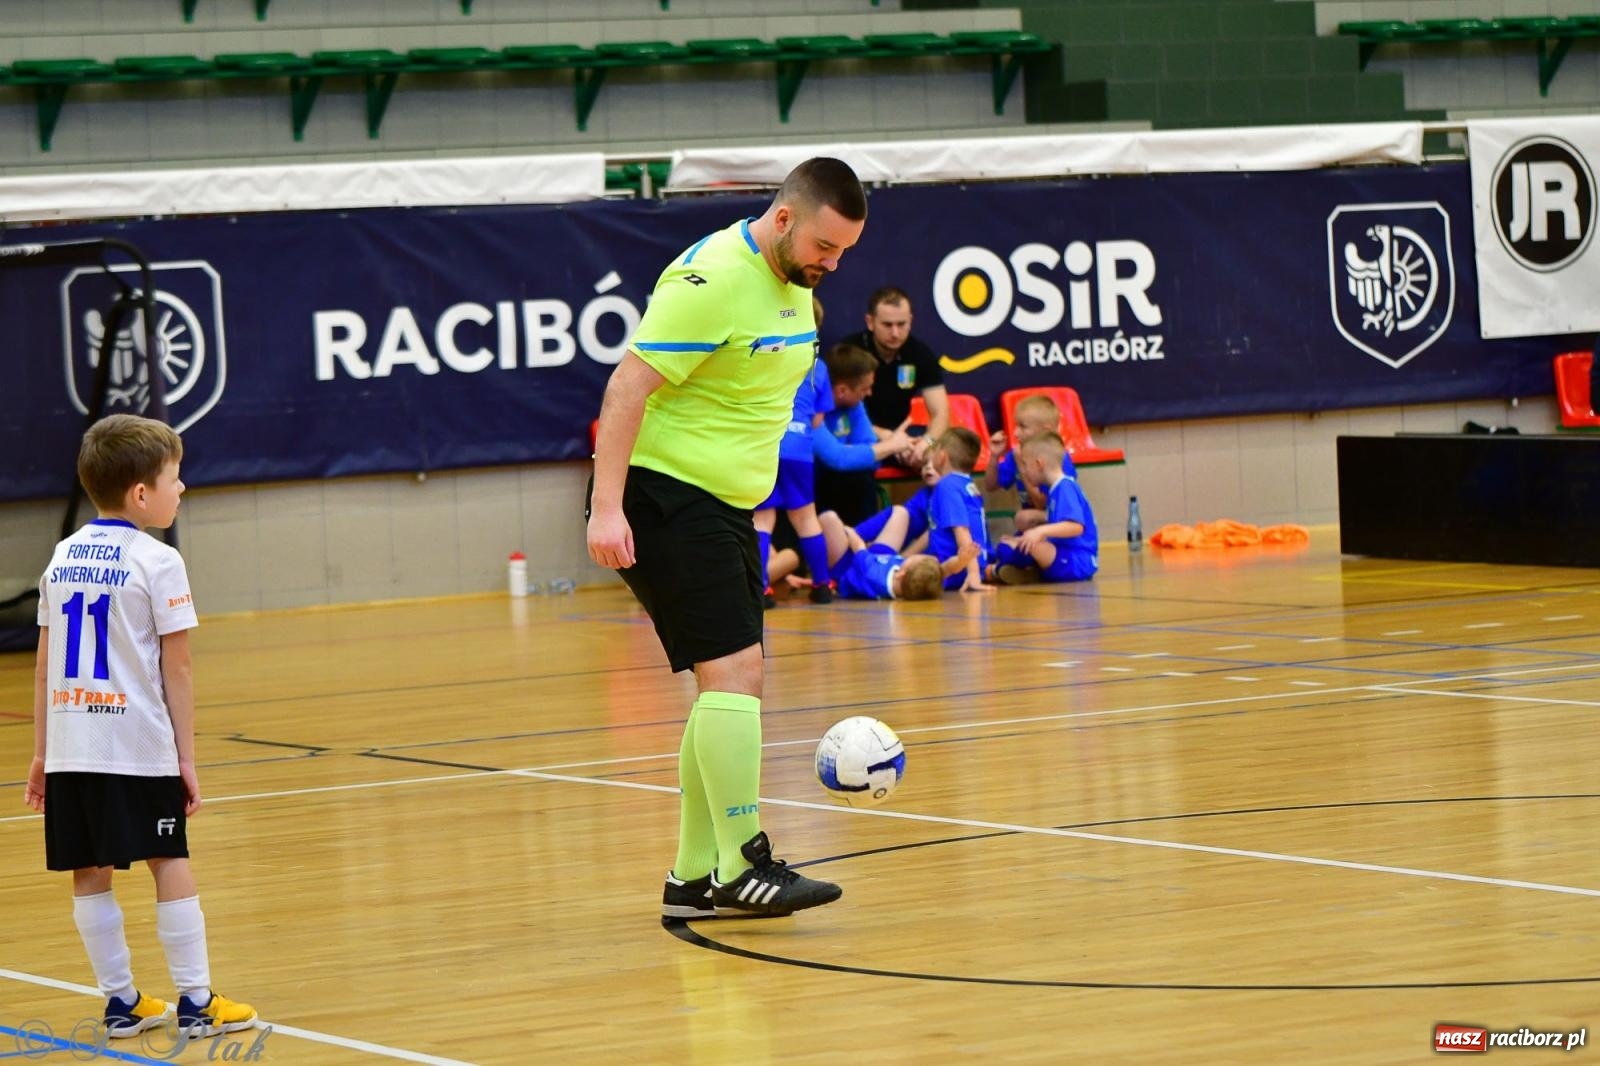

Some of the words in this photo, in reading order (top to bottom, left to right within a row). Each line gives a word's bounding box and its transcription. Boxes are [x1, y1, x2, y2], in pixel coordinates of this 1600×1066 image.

[1509, 161, 1581, 242] JR
[313, 271, 654, 381] RACIBÓ
[1027, 329, 1165, 367] RACIBÓRZ
[66, 543, 121, 562] FORTECA
[62, 592, 111, 680] 11
